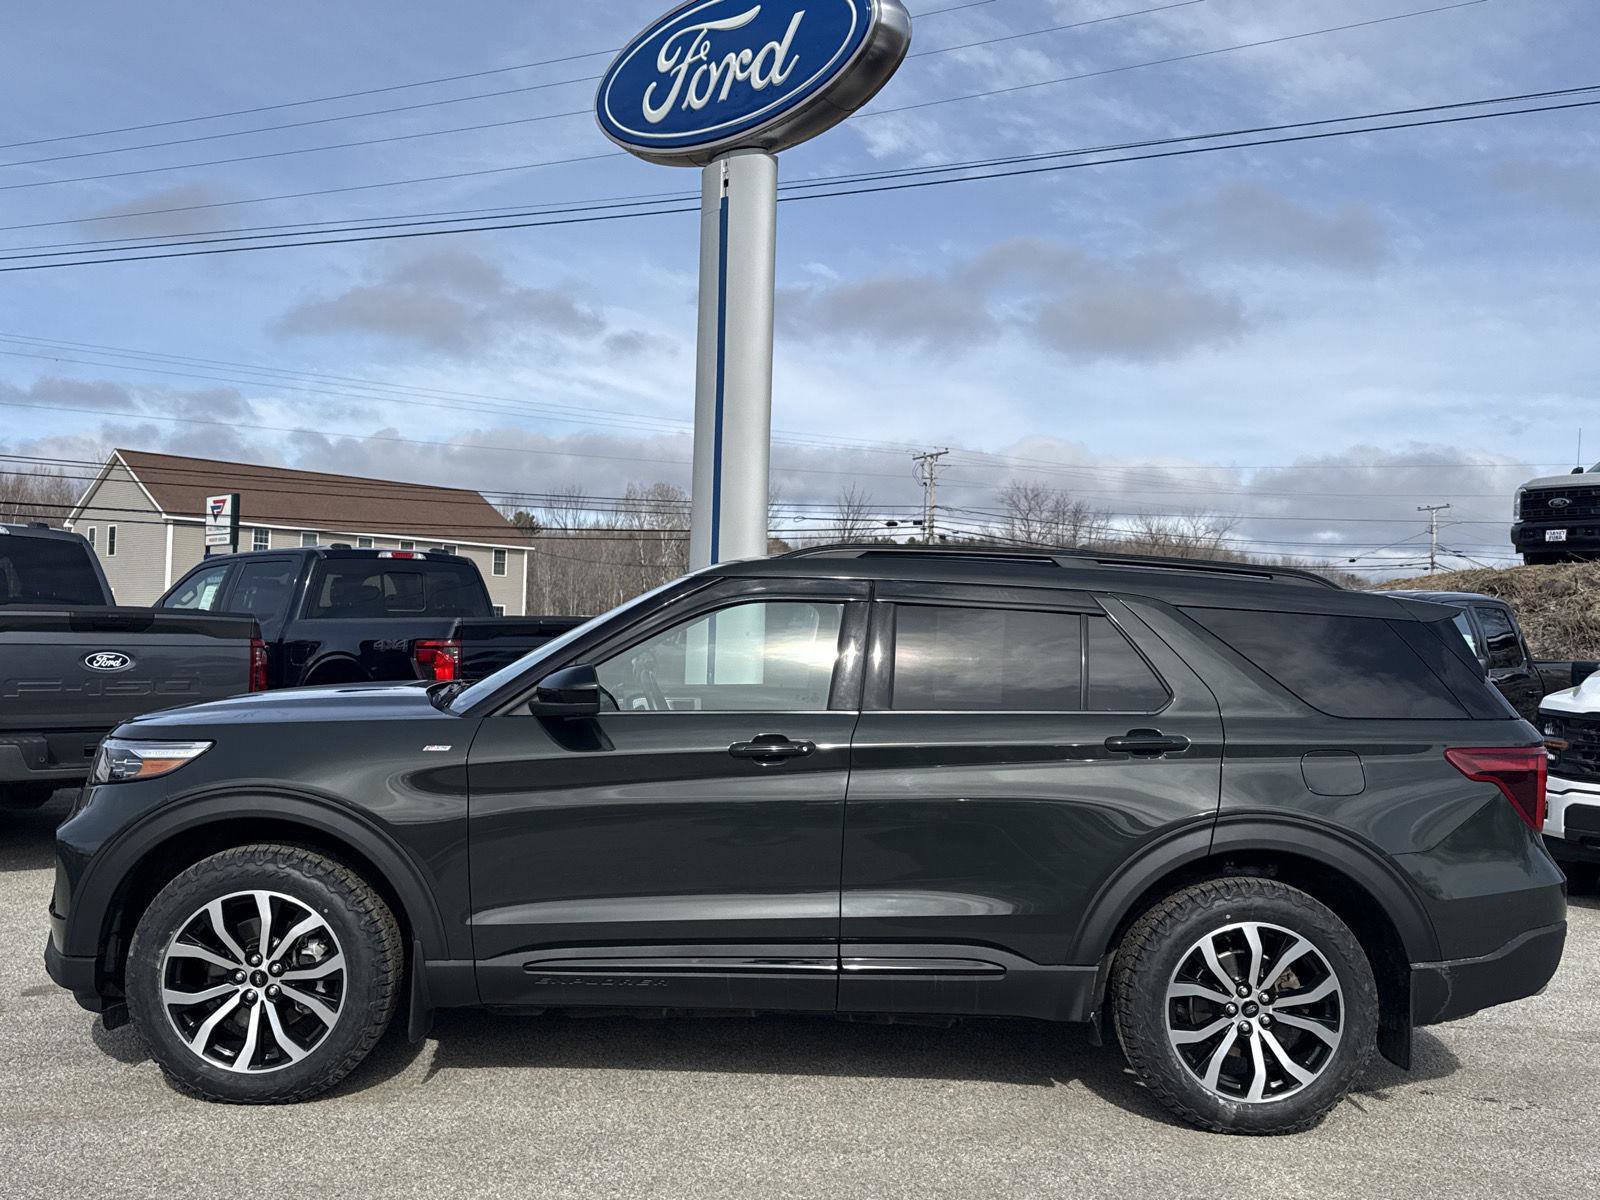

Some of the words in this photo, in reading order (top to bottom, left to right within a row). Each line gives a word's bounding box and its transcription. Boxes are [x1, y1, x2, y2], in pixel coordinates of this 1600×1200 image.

[642, 5, 805, 123] Ford
[93, 654, 123, 667] Ford
[3, 678, 201, 698] F-150
